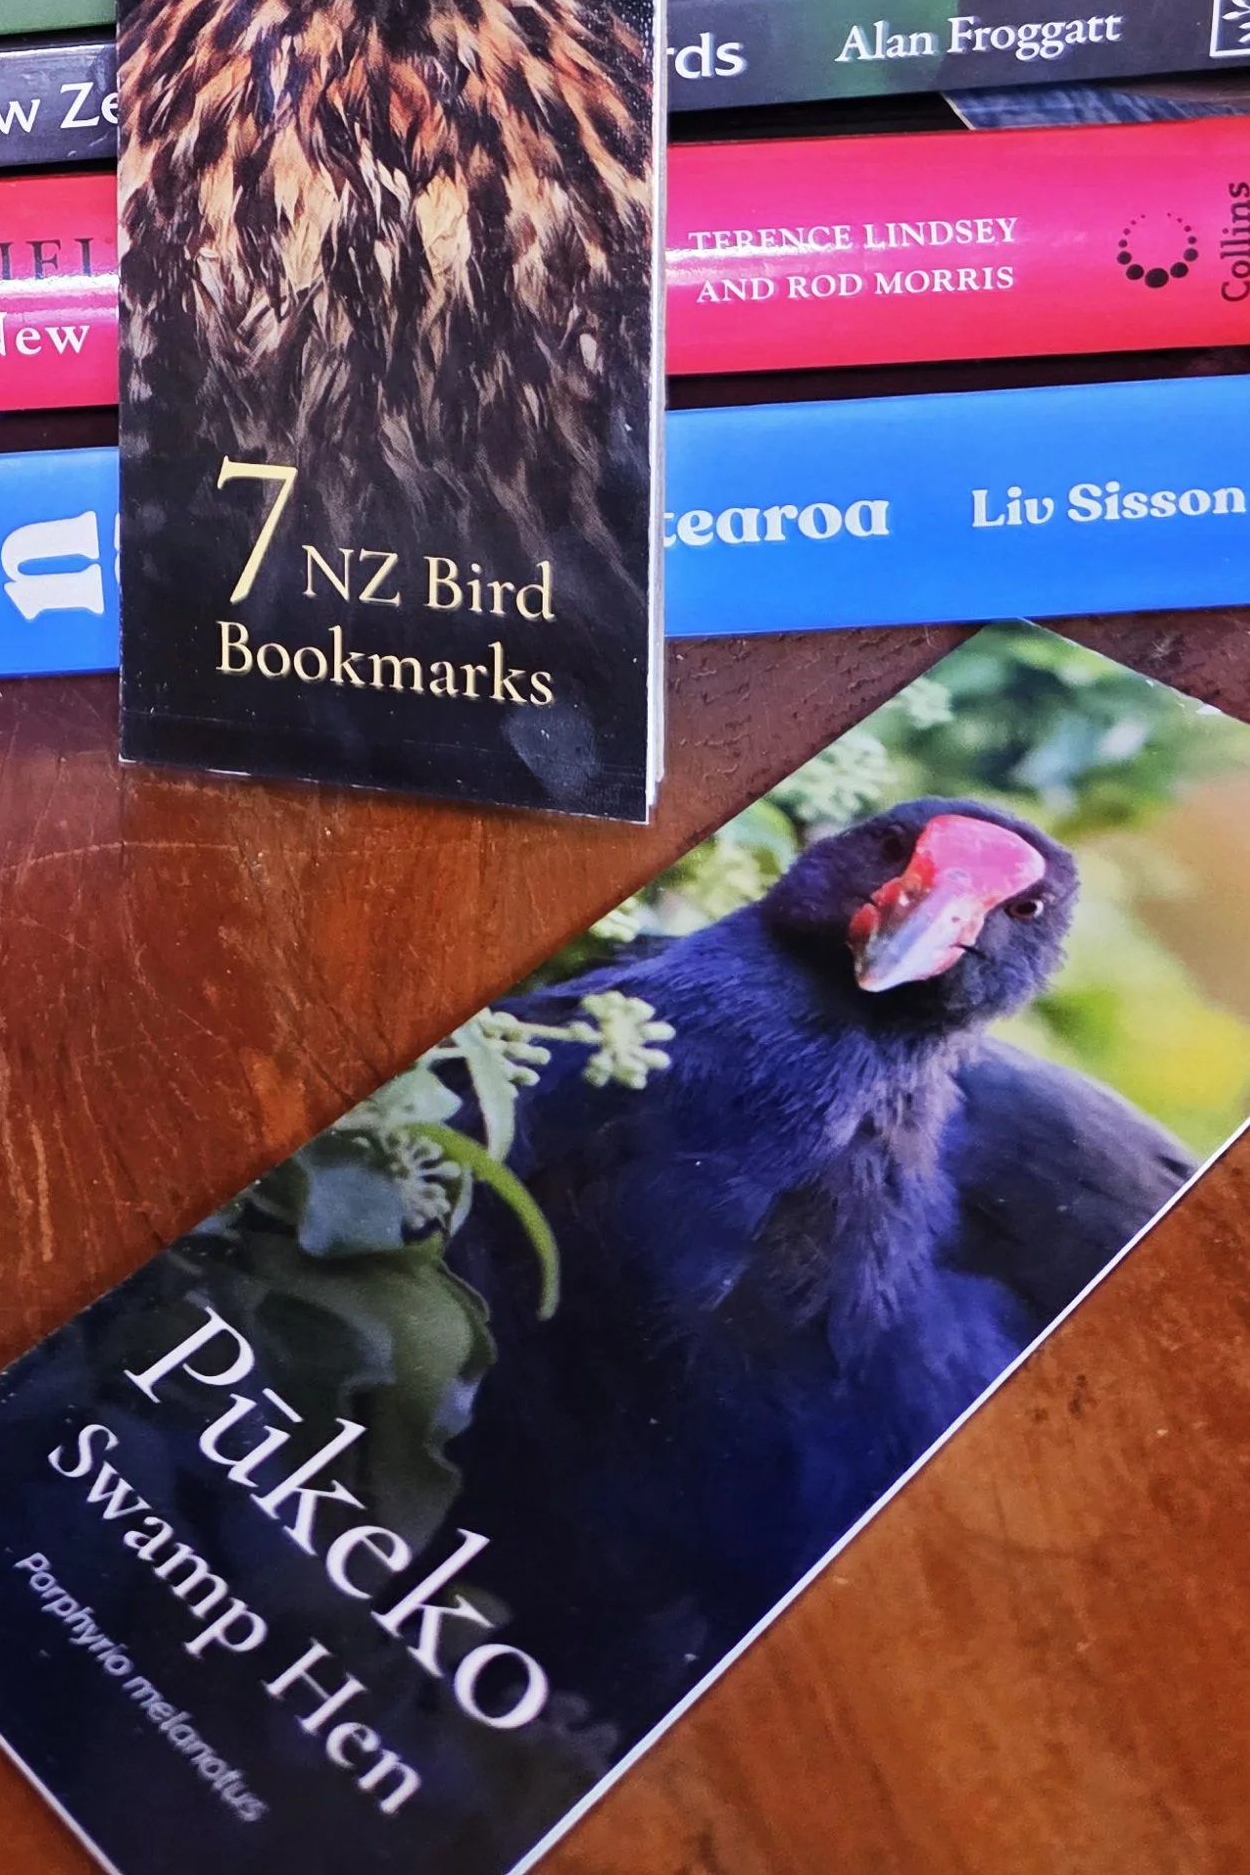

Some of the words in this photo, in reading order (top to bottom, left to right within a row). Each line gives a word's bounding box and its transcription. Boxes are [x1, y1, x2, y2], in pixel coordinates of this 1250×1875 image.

[834, 19, 937, 63] Alan
[947, 13, 1125, 62] Froggatt
[687, 225, 854, 252] TERENCE
[863, 217, 1018, 249] LINDSEY
[696, 277, 776, 303] AND
[787, 272, 863, 299] ROD
[874, 266, 1015, 296] MORRIS
[1220, 181, 1250, 302] Collins
[216, 454, 299, 604] 7
[301, 544, 401, 607] NZ
[423, 555, 556, 622] Bird
[970, 486, 1055, 528] Liv
[1066, 480, 1247, 523] Sisson
[215, 620, 555, 707] Bookmarks
[124, 1305, 550, 1730] Pūkeko
[47, 1423, 269, 1660] Swamp
[262, 1636, 423, 1816] Hen
[11, 1551, 135, 1677] Porphyrio
[121, 1675, 268, 1823] melanotus
